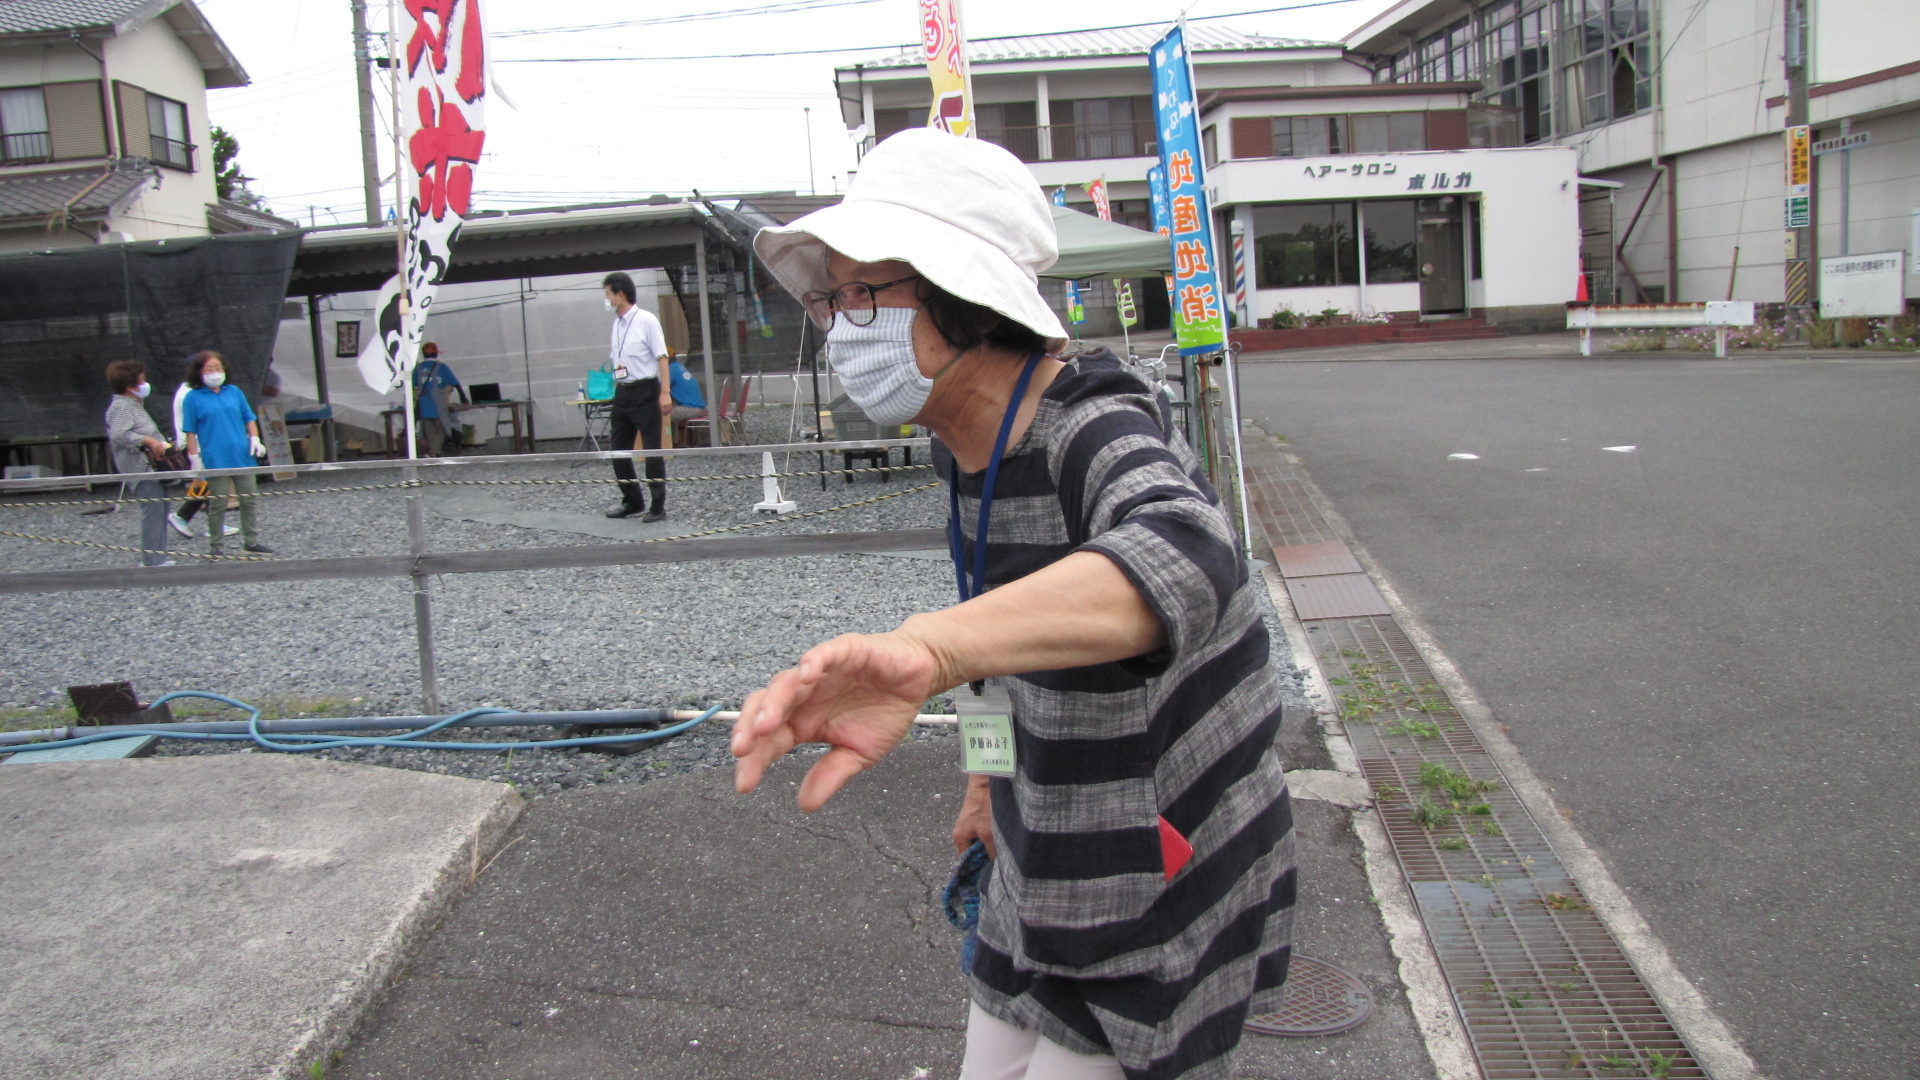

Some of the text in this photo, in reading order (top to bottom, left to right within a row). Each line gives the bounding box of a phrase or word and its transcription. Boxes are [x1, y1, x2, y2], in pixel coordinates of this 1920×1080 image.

[1303, 162, 1397, 178] ヘアーサロン
